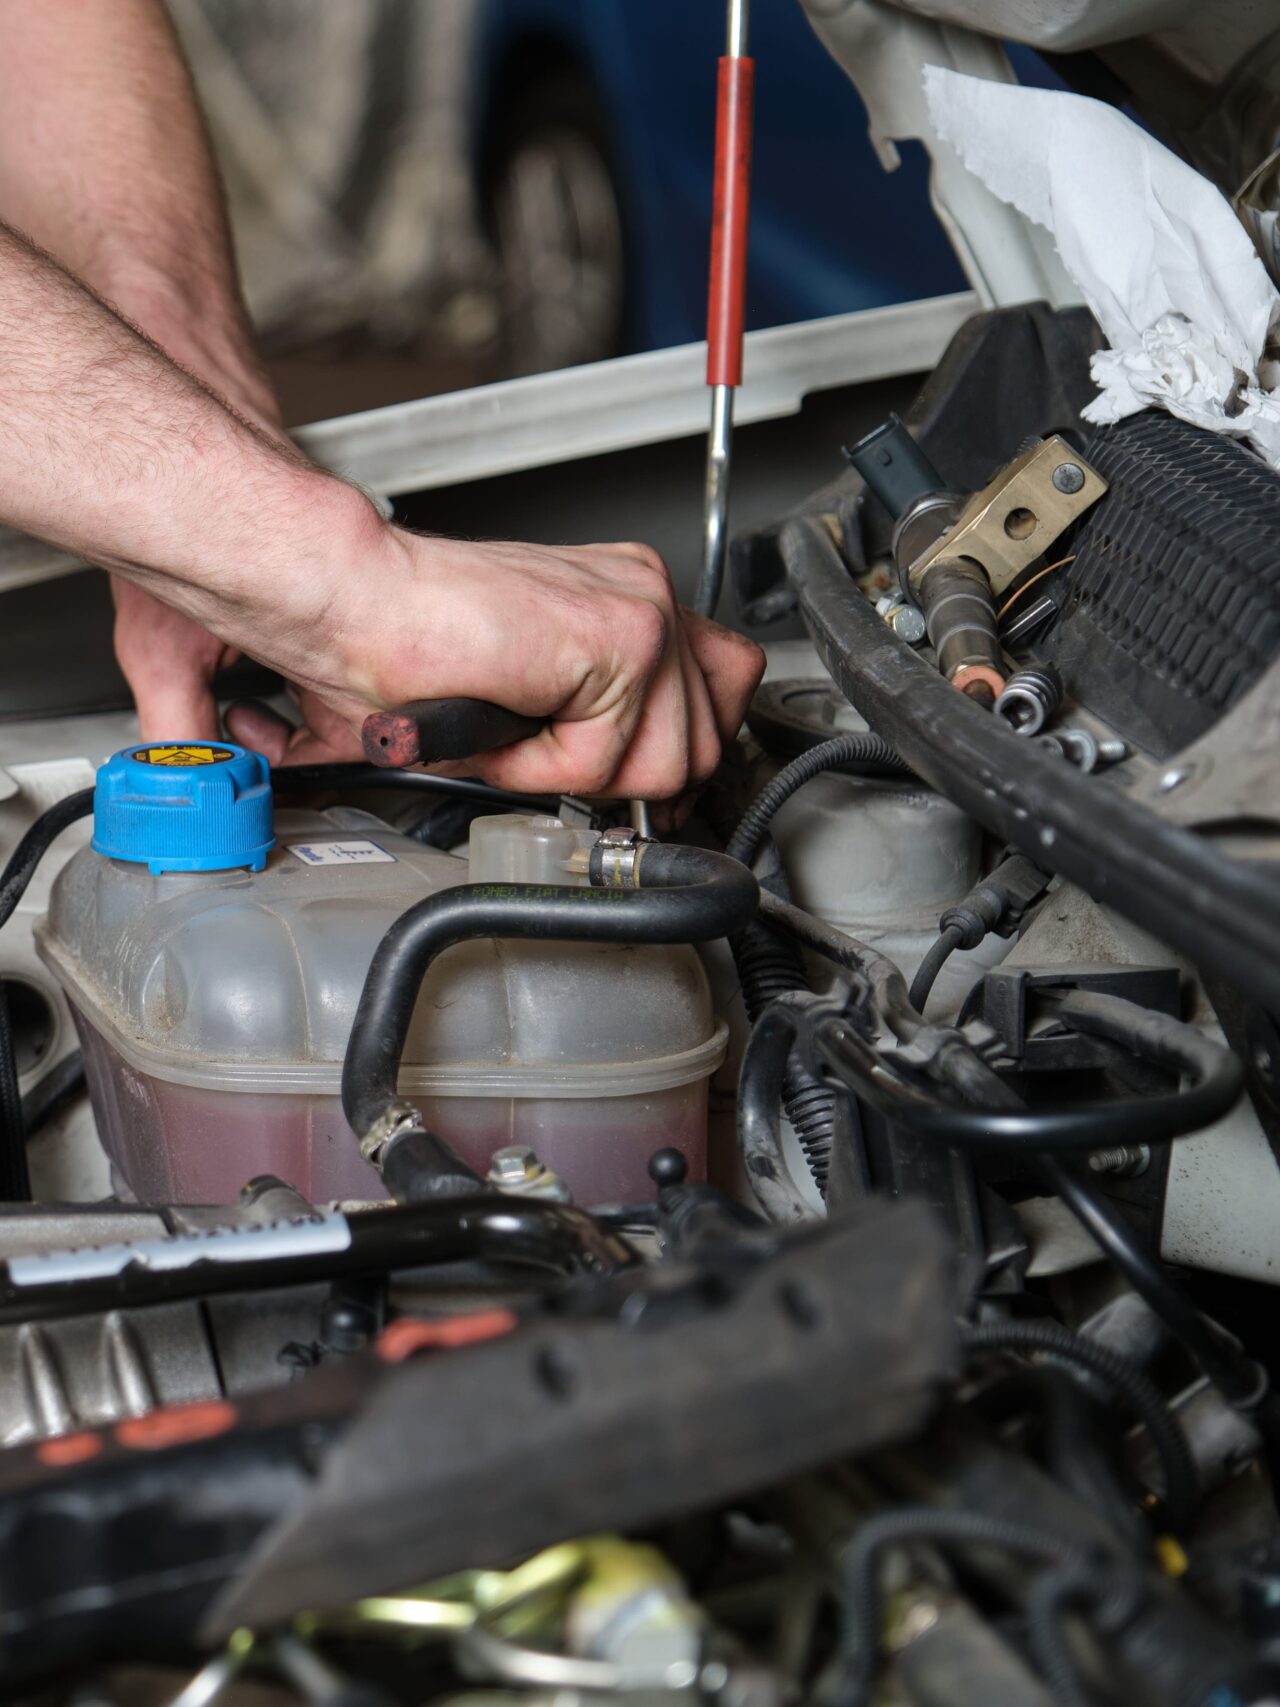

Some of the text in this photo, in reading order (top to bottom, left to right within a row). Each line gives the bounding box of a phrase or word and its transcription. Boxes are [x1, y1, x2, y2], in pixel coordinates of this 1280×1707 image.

[472, 886, 517, 898] ROMEO
[524, 887, 560, 898] FIAT
[569, 888, 624, 900] LANCIA
